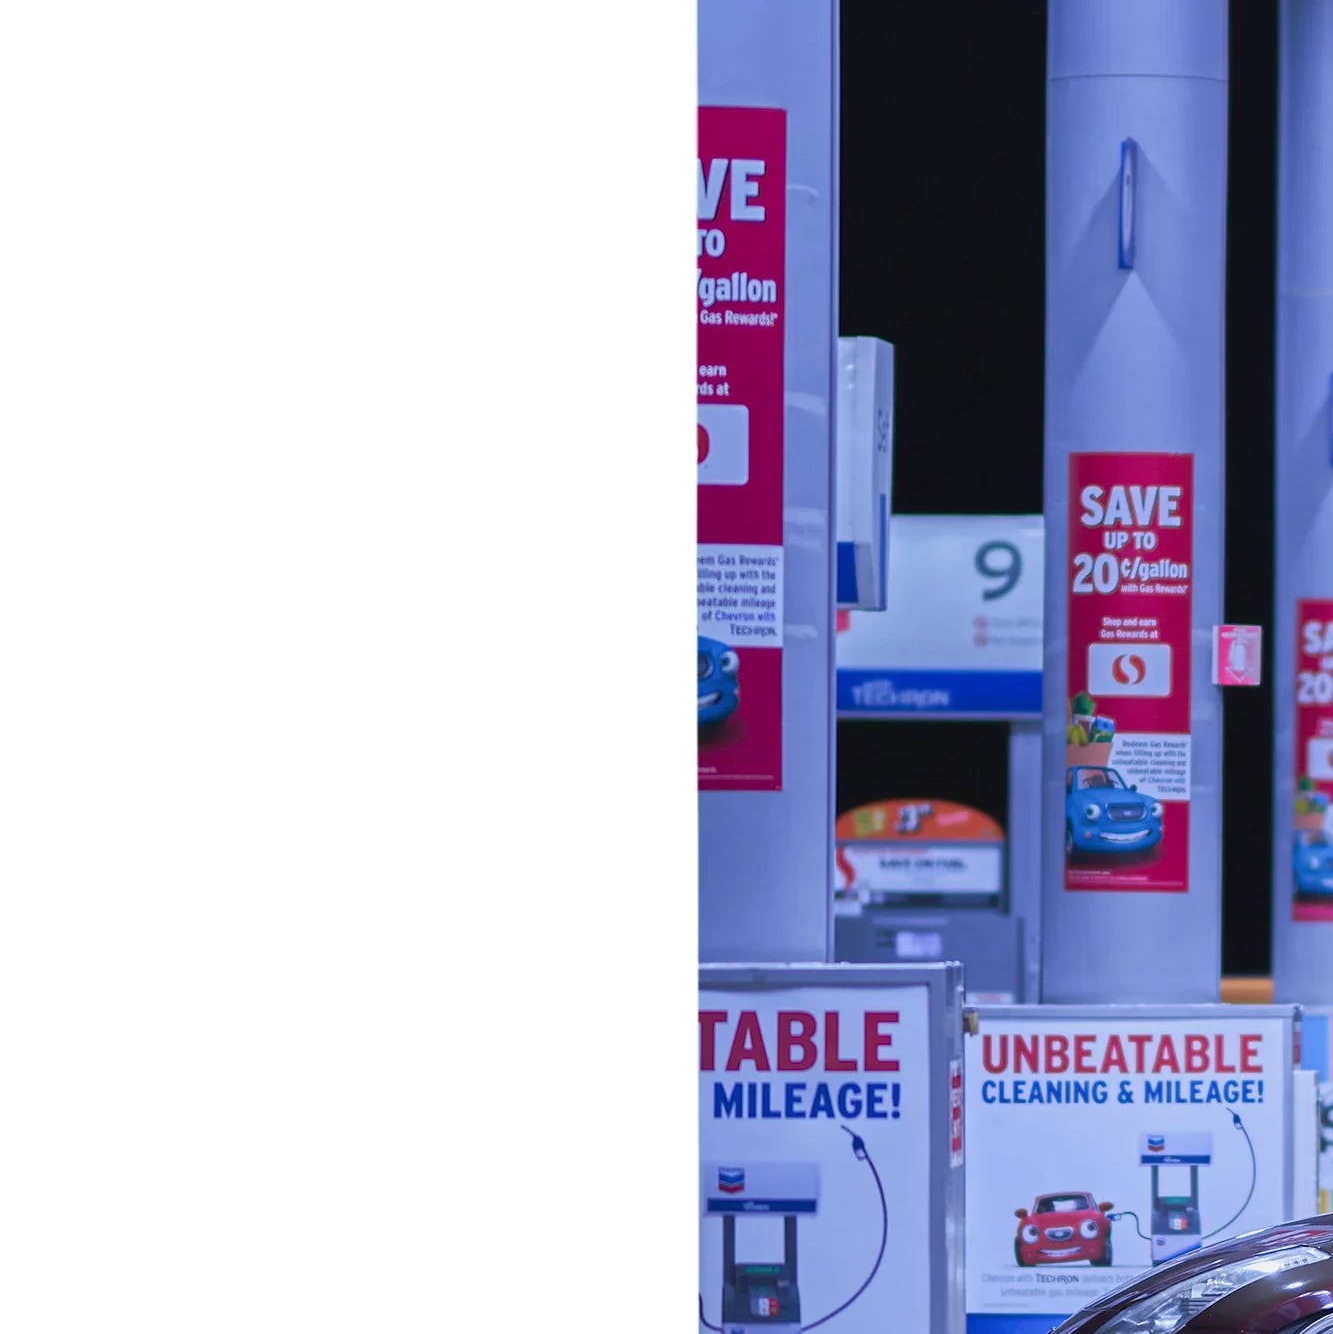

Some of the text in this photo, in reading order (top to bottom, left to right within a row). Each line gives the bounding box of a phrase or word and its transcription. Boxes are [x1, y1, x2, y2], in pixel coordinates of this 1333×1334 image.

[697, 269, 777, 307] gallon
[700, 309, 722, 325] Gas
[699, 365, 727, 377] earn
[716, 383, 729, 396] at
[1080, 485, 1181, 527] SAVE
[1104, 531, 1156, 550] UP TO
[974, 540, 1022, 601] 9
[1072, 553, 1119, 594] 20
[1121, 583, 1138, 593] with
[1140, 584, 1153, 593] Gas
[1103, 617, 1121, 627] Shop
[1123, 617, 1137, 626] and
[1101, 629, 1158, 638] Gas Rewards at
[698, 1010, 900, 1071] TABLE
[982, 1034, 1263, 1074] UNBEATABLE
[714, 1083, 900, 1119] MILEAGE!
[981, 1080, 1264, 1104] CLEANING & MILEAGE!
[1036, 1273, 1079, 1284] TECHRON
